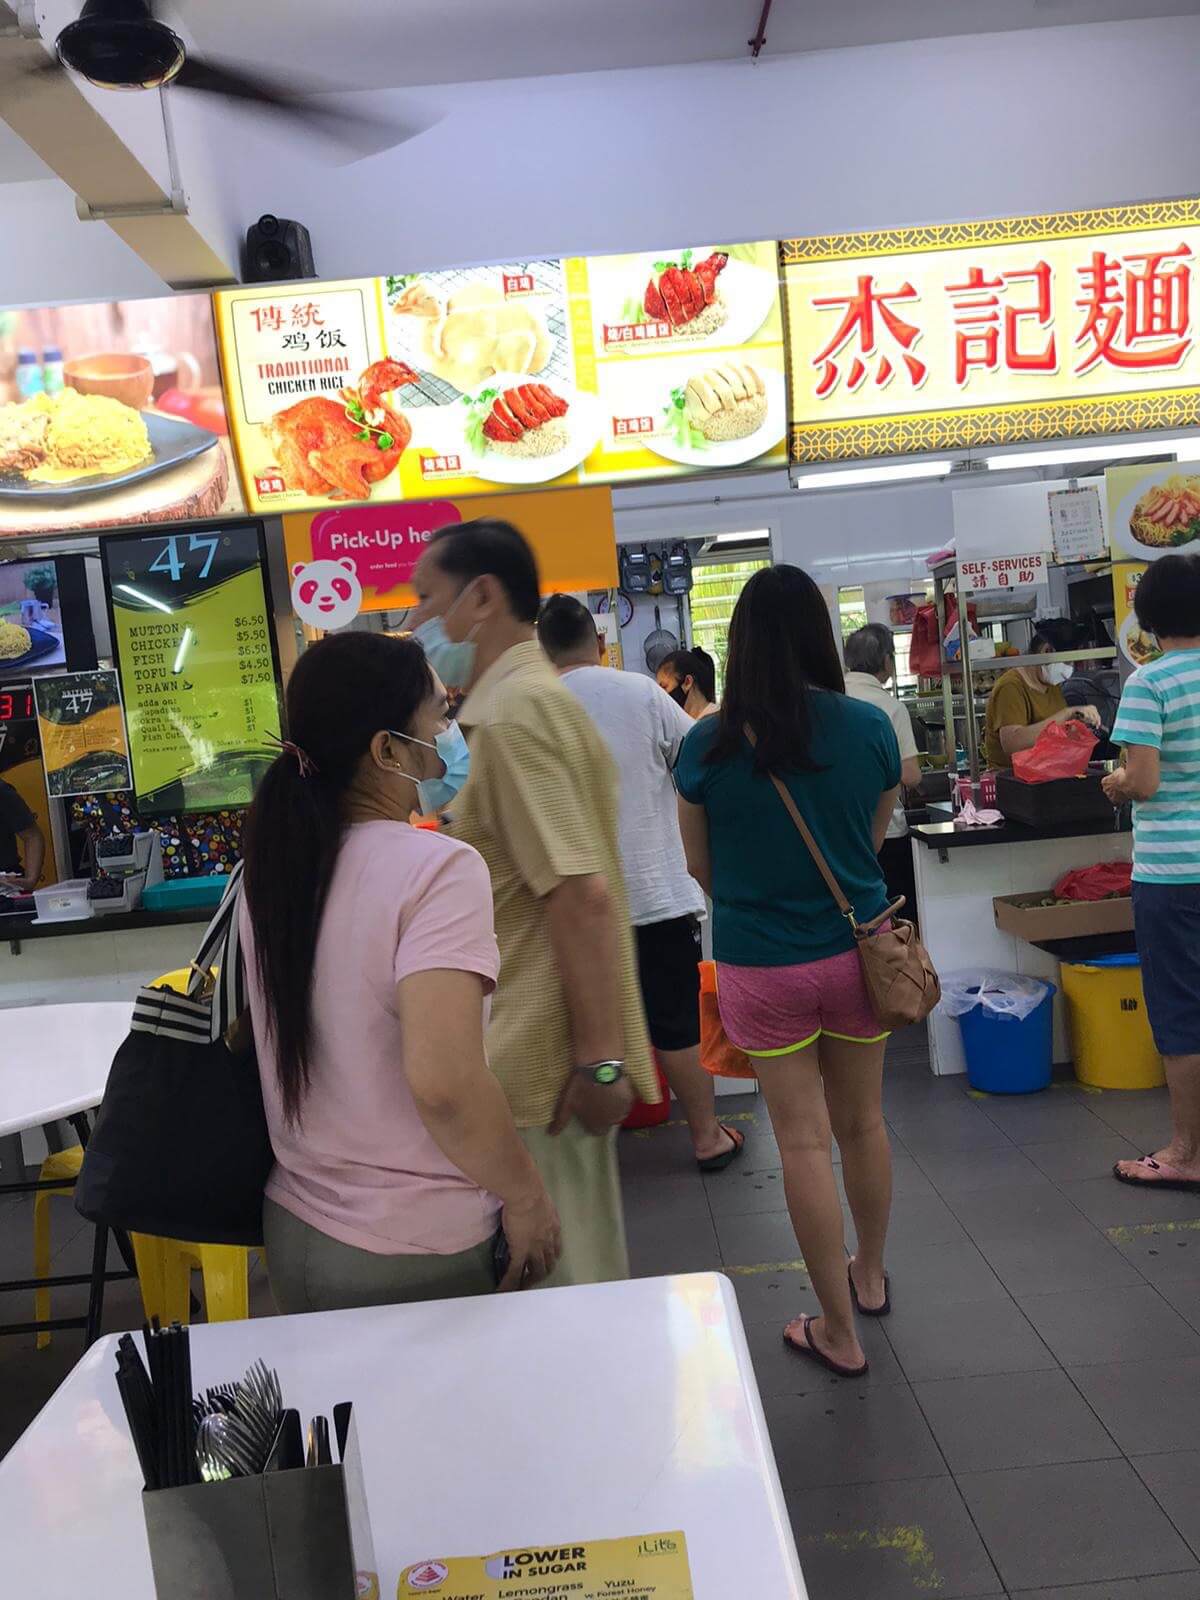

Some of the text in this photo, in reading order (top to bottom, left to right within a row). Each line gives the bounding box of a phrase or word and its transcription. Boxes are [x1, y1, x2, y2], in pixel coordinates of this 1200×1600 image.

[811, 242, 1192, 396] 杰記麵
[282, 329, 347, 351] 鸡饭
[257, 356, 351, 379] TRADITIONAL
[268, 376, 345, 395] CHICKEN RICE
[330, 527, 403, 550] Pick-Up
[148, 534, 219, 581] 47
[129, 615, 264, 637] MUTTON $6.50
[131, 629, 266, 651] CHICKE $5.50
[133, 643, 267, 666] FISH $6.50
[134, 657, 269, 680] TOFU $4.50
[137, 672, 271, 694] PRAWN $7.50
[65, 697, 93, 713] 47
[504, 1547, 586, 1567] LOWER
[503, 1562, 587, 1580] IN SUGAR
[498, 1579, 635, 1599] Lemongrass Yuzu
